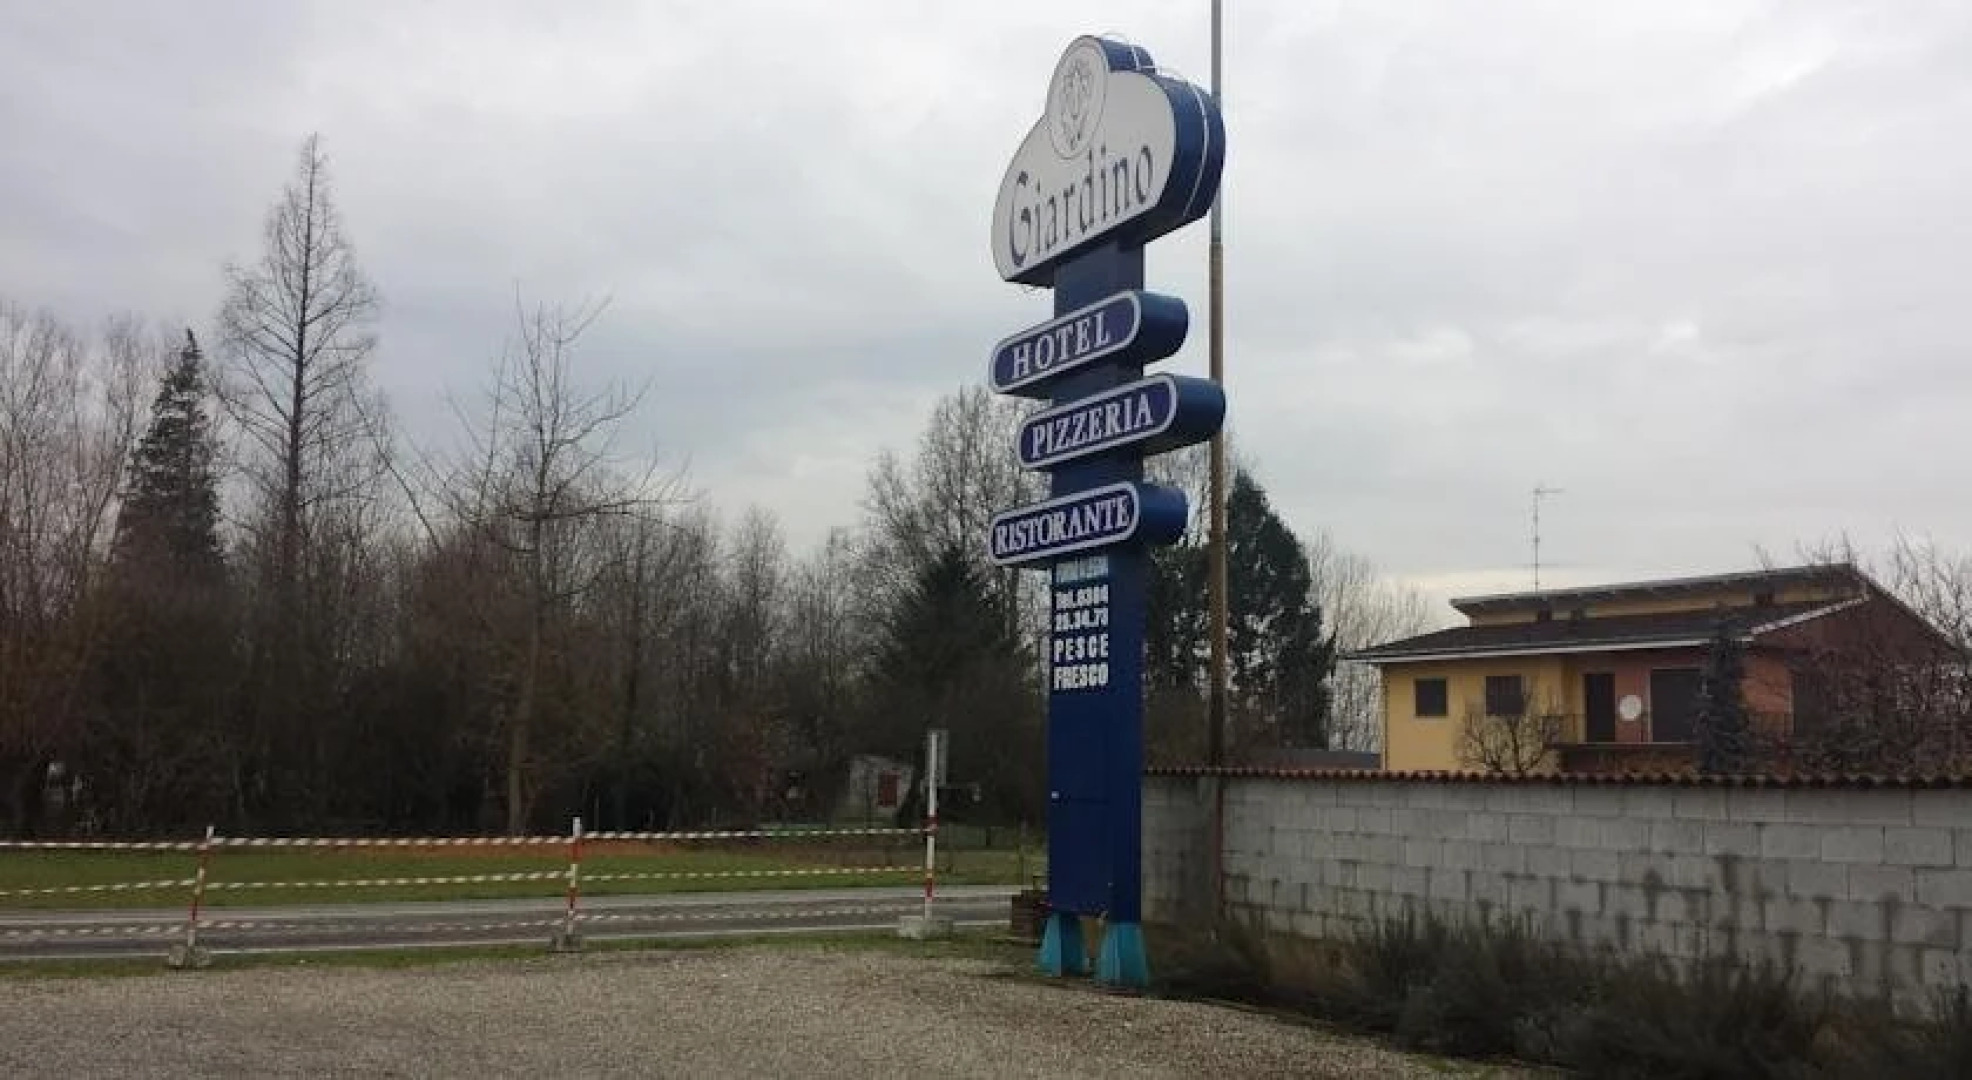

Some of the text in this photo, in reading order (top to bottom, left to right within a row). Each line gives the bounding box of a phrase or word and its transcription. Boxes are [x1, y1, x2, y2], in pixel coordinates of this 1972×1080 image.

[1009, 144, 1153, 267] Giardino
[1012, 311, 1110, 379] HOTEL
[1031, 393, 1153, 459] PIZZERIA
[995, 495, 1131, 554] RISTORANTE
[1053, 633, 1109, 663] PESCE
[1053, 662, 1109, 690] FRESCO
